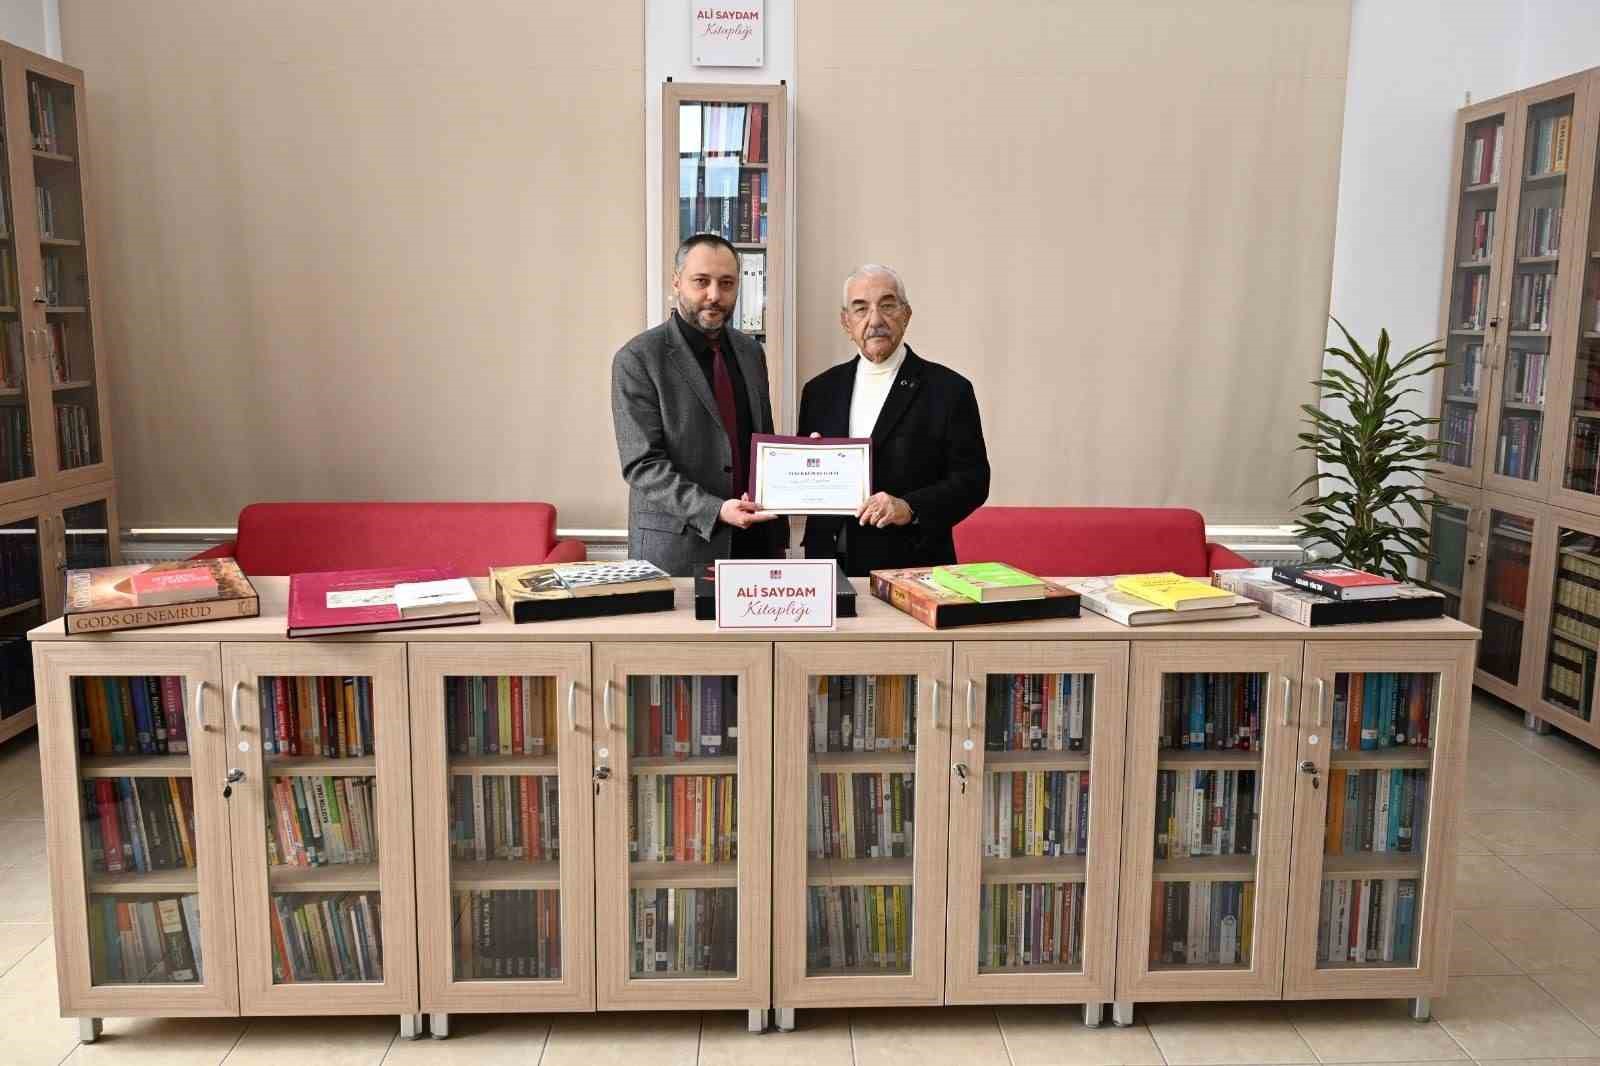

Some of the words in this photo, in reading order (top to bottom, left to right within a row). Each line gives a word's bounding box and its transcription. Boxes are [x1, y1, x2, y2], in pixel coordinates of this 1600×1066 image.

[697, 8, 713, 20] ALİ
[715, 10, 759, 21] SAYDAM
[699, 23, 753, 40] Kitaplığı
[737, 585, 757, 598] ALİ
[761, 587, 816, 598] SAYDAM
[76, 615, 119, 630] GODS
[122, 613, 145, 626] OF
[146, 606, 212, 623] NEMRUD
[742, 601, 811, 622] Kitaplığı
